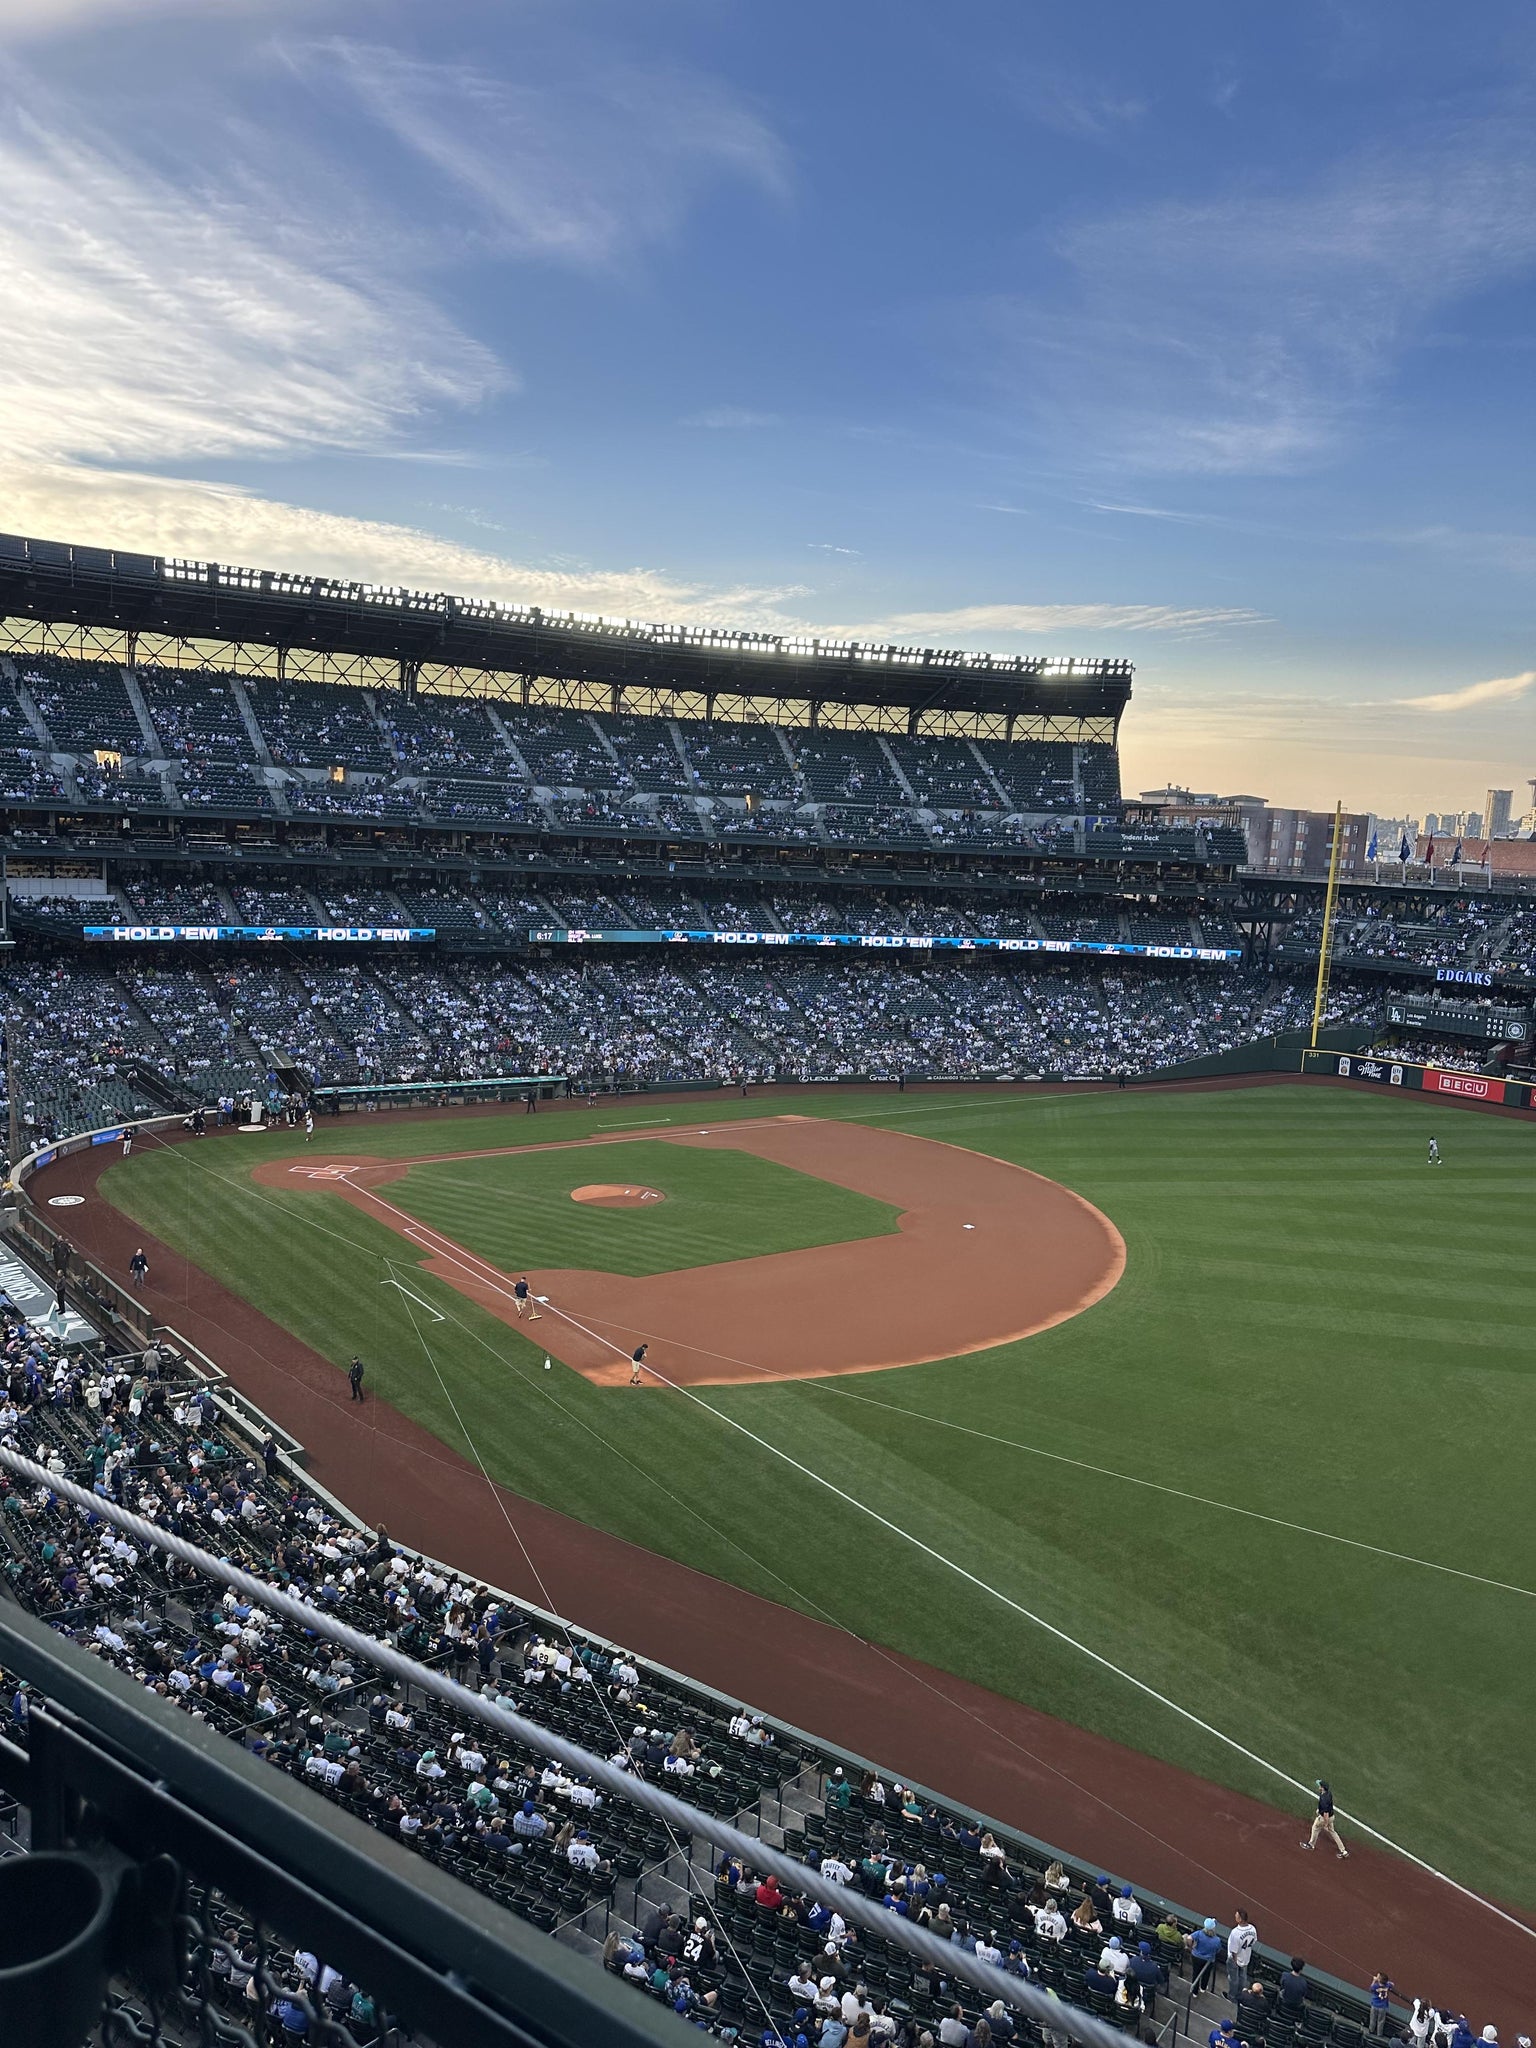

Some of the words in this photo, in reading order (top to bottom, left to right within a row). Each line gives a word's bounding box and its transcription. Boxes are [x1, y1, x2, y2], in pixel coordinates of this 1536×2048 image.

[114, 927, 175, 940] HOLD
[317, 928, 372, 941] HOLD
[536, 932, 553, 940] 6:17
[713, 932, 758, 944] HOLD
[861, 936, 903, 948] HOLD
[999, 939, 1039, 951] HOLD
[1145, 946, 1193, 958] HOLD
[1436, 969, 1492, 987] EDGAR'S
[1442, 1078, 1485, 1094] BECU
[539, 1653, 549, 1664] 29
[731, 1726, 740, 1736] 51
[517, 1785, 528, 1799] 51
[823, 1862, 841, 1871] GRIFFEY
[825, 1870, 838, 1882] 24
[1119, 1911, 1129, 1921] 19
[1040, 1922, 1054, 1936] 44
[683, 1939, 704, 1962] 24
